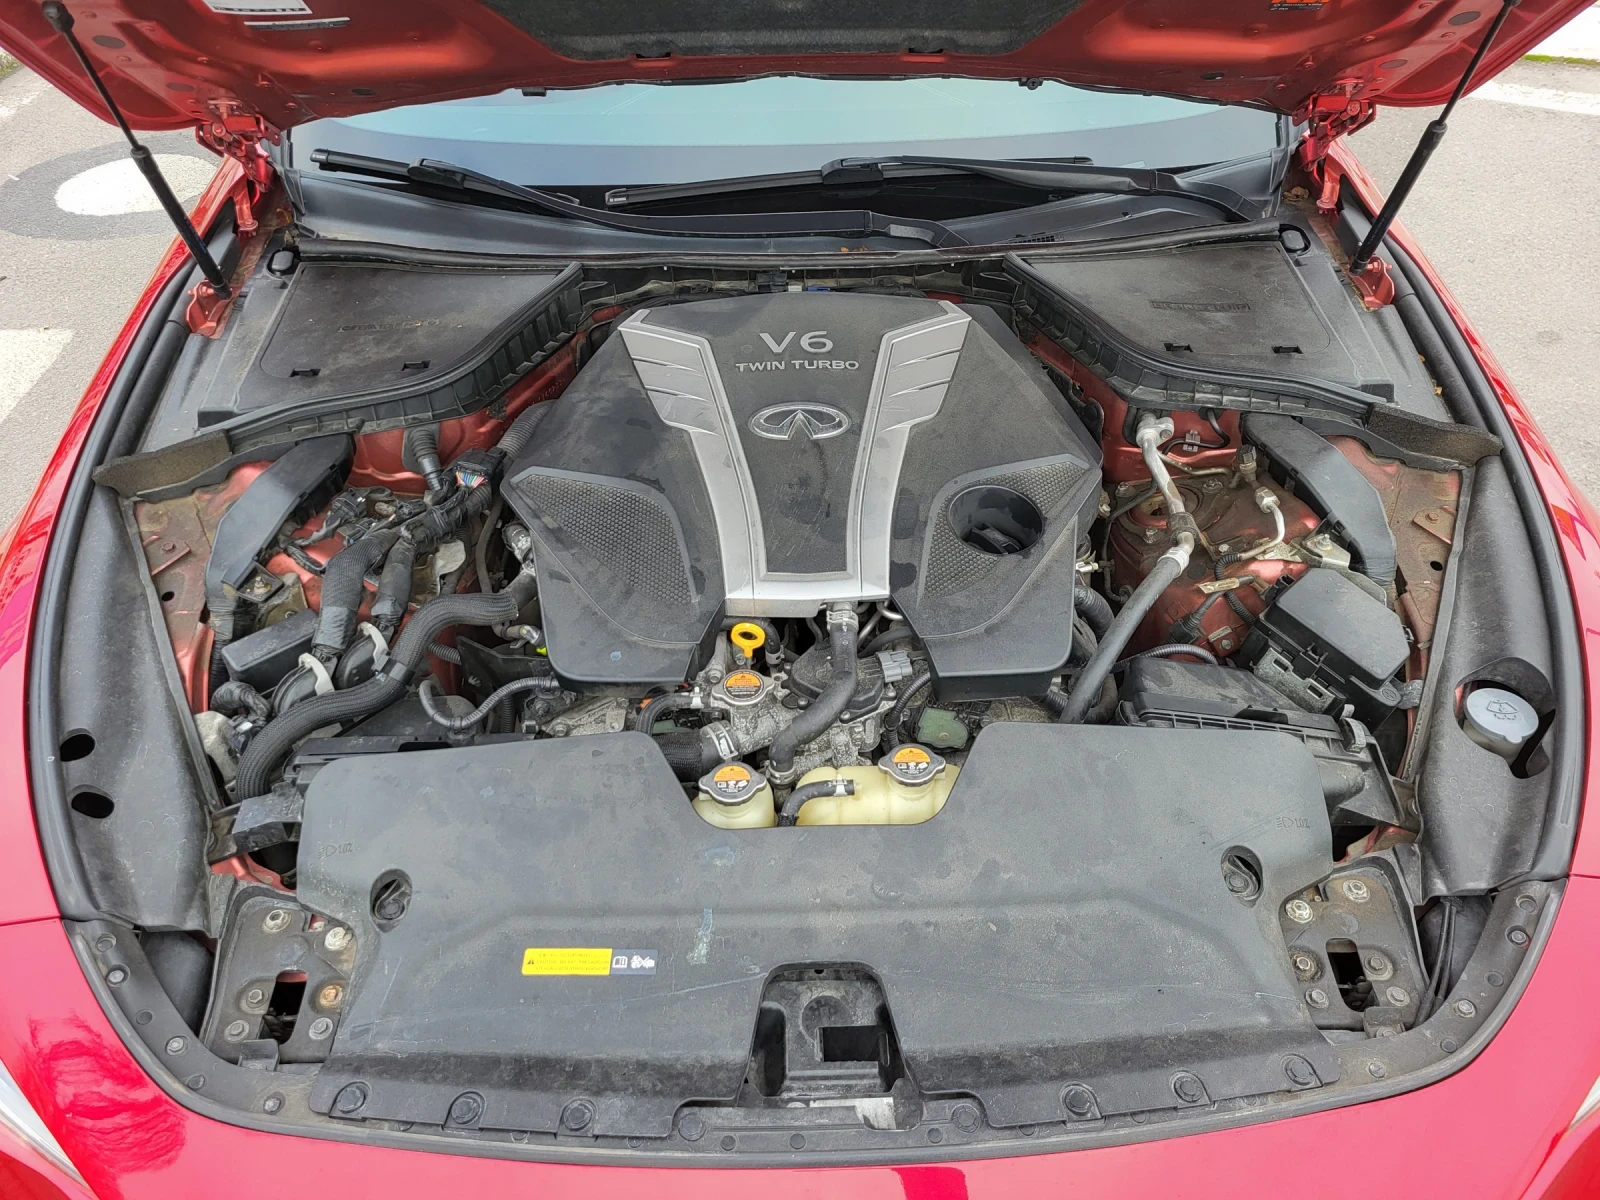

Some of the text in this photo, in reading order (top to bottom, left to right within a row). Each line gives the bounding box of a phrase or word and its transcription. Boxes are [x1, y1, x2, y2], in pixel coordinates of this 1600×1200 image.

[759, 331, 834, 353] V6
[735, 360, 859, 372] TWIN TURBO
